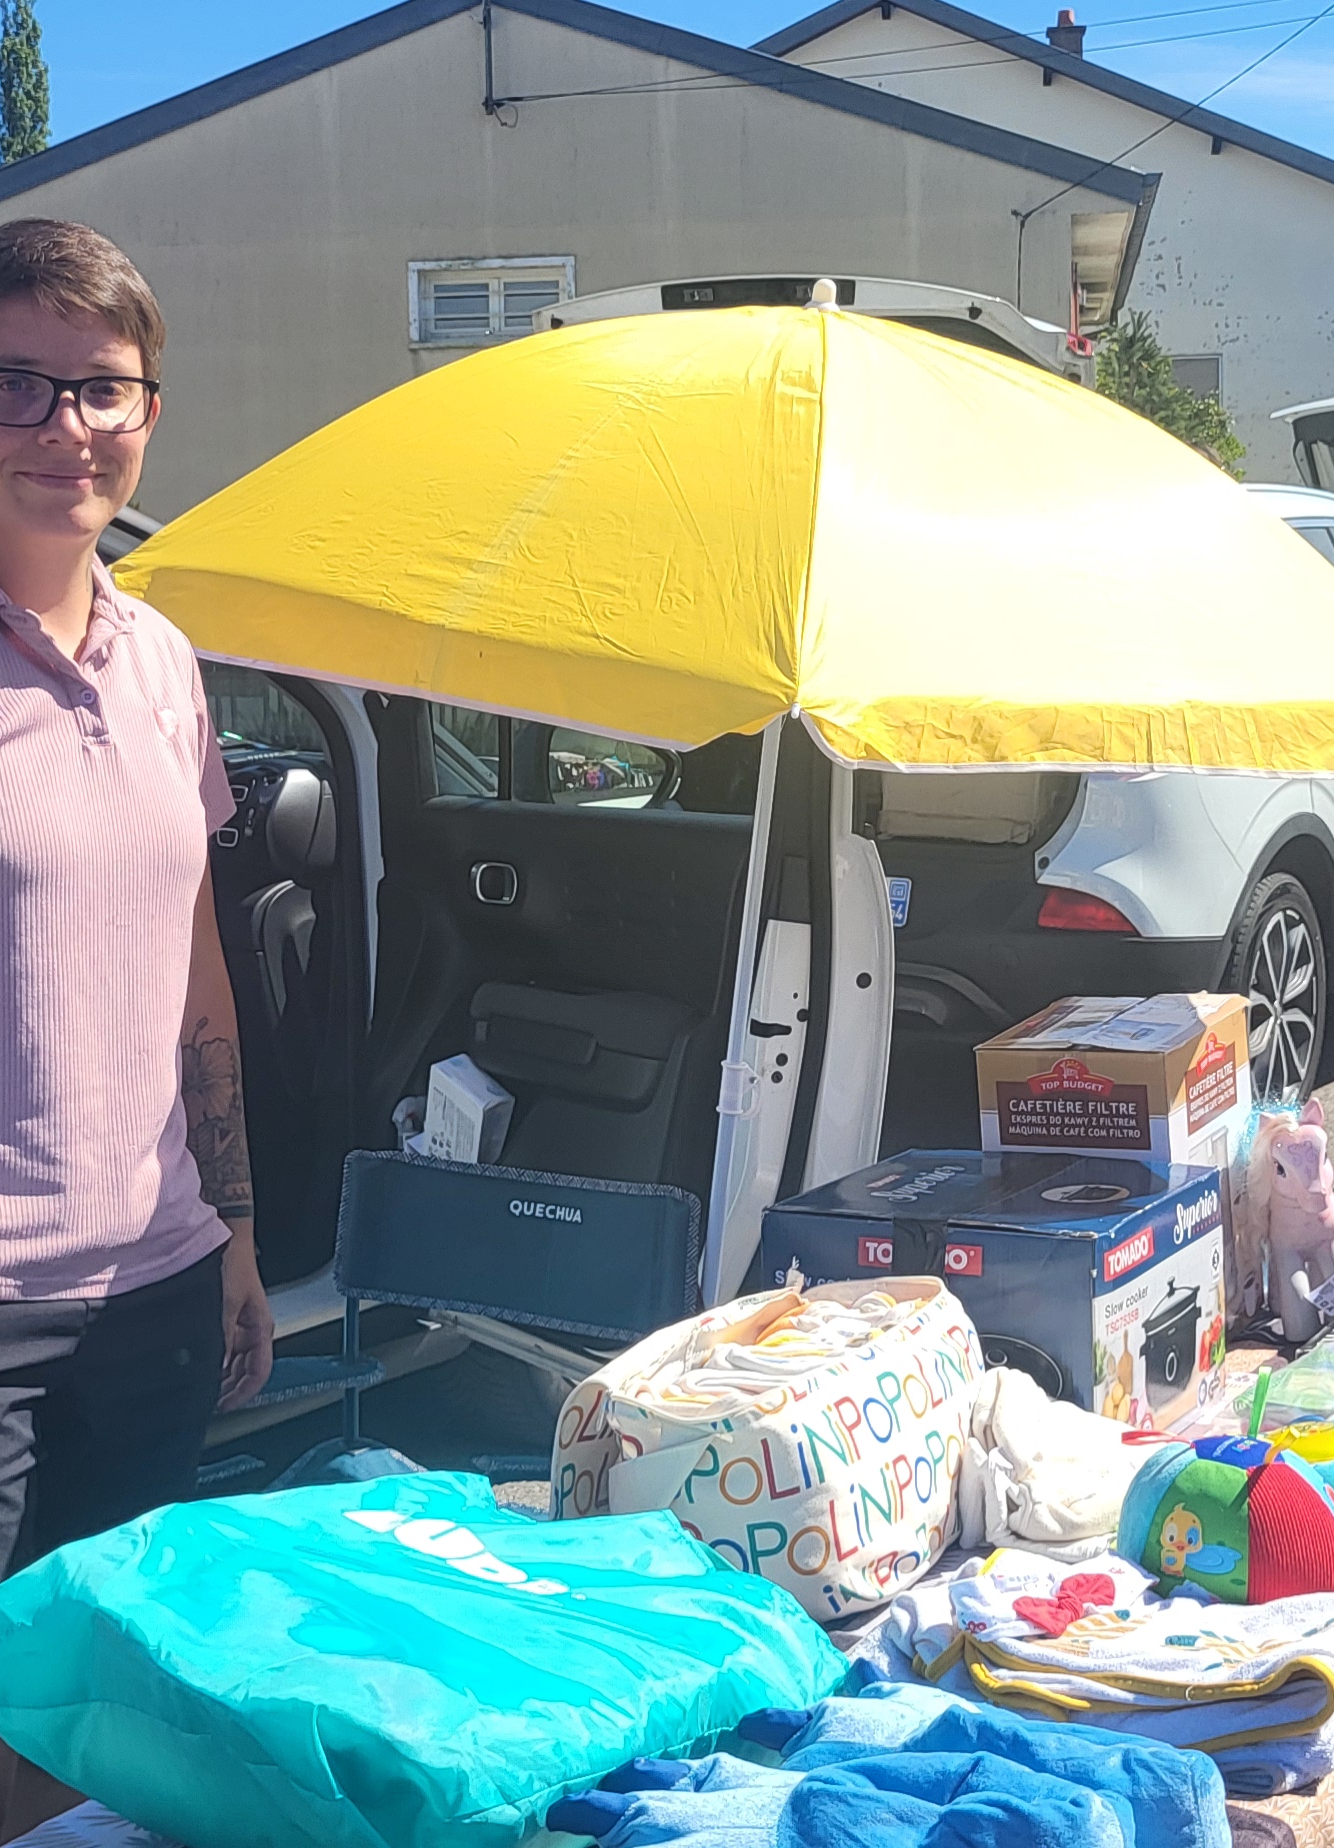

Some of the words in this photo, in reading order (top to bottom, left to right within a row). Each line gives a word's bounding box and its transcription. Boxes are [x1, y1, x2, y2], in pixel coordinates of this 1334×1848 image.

[1040, 1081, 1060, 1090] TOP
[1063, 1081, 1105, 1092] BUDGET
[1009, 1098, 1084, 1113] CAFETIÈRE
[1088, 1102, 1137, 1115] FILTRE
[1011, 1115, 1047, 1125] EKSPRES
[1049, 1116, 1062, 1125] DO
[1064, 1116, 1089, 1126] KAWY
[1092, 1117, 1098, 1126] Z
[1099, 1117, 1137, 1127] FILTREM
[1050, 1127, 1061, 1136] DE
[1063, 1126, 1086, 1137] CAFÉ
[1088, 1128, 1107, 1137] COM
[1109, 1129, 1141, 1138] FILTRO
[509, 1200, 582, 1224] QUECHUA
[1174, 1189, 1218, 1244] Superior
[866, 1241, 968, 1270] TOO
[1108, 1236, 1150, 1275] TOMADO
[1105, 1301, 1124, 1319] Slow
[1125, 1286, 1148, 1308] cooker
